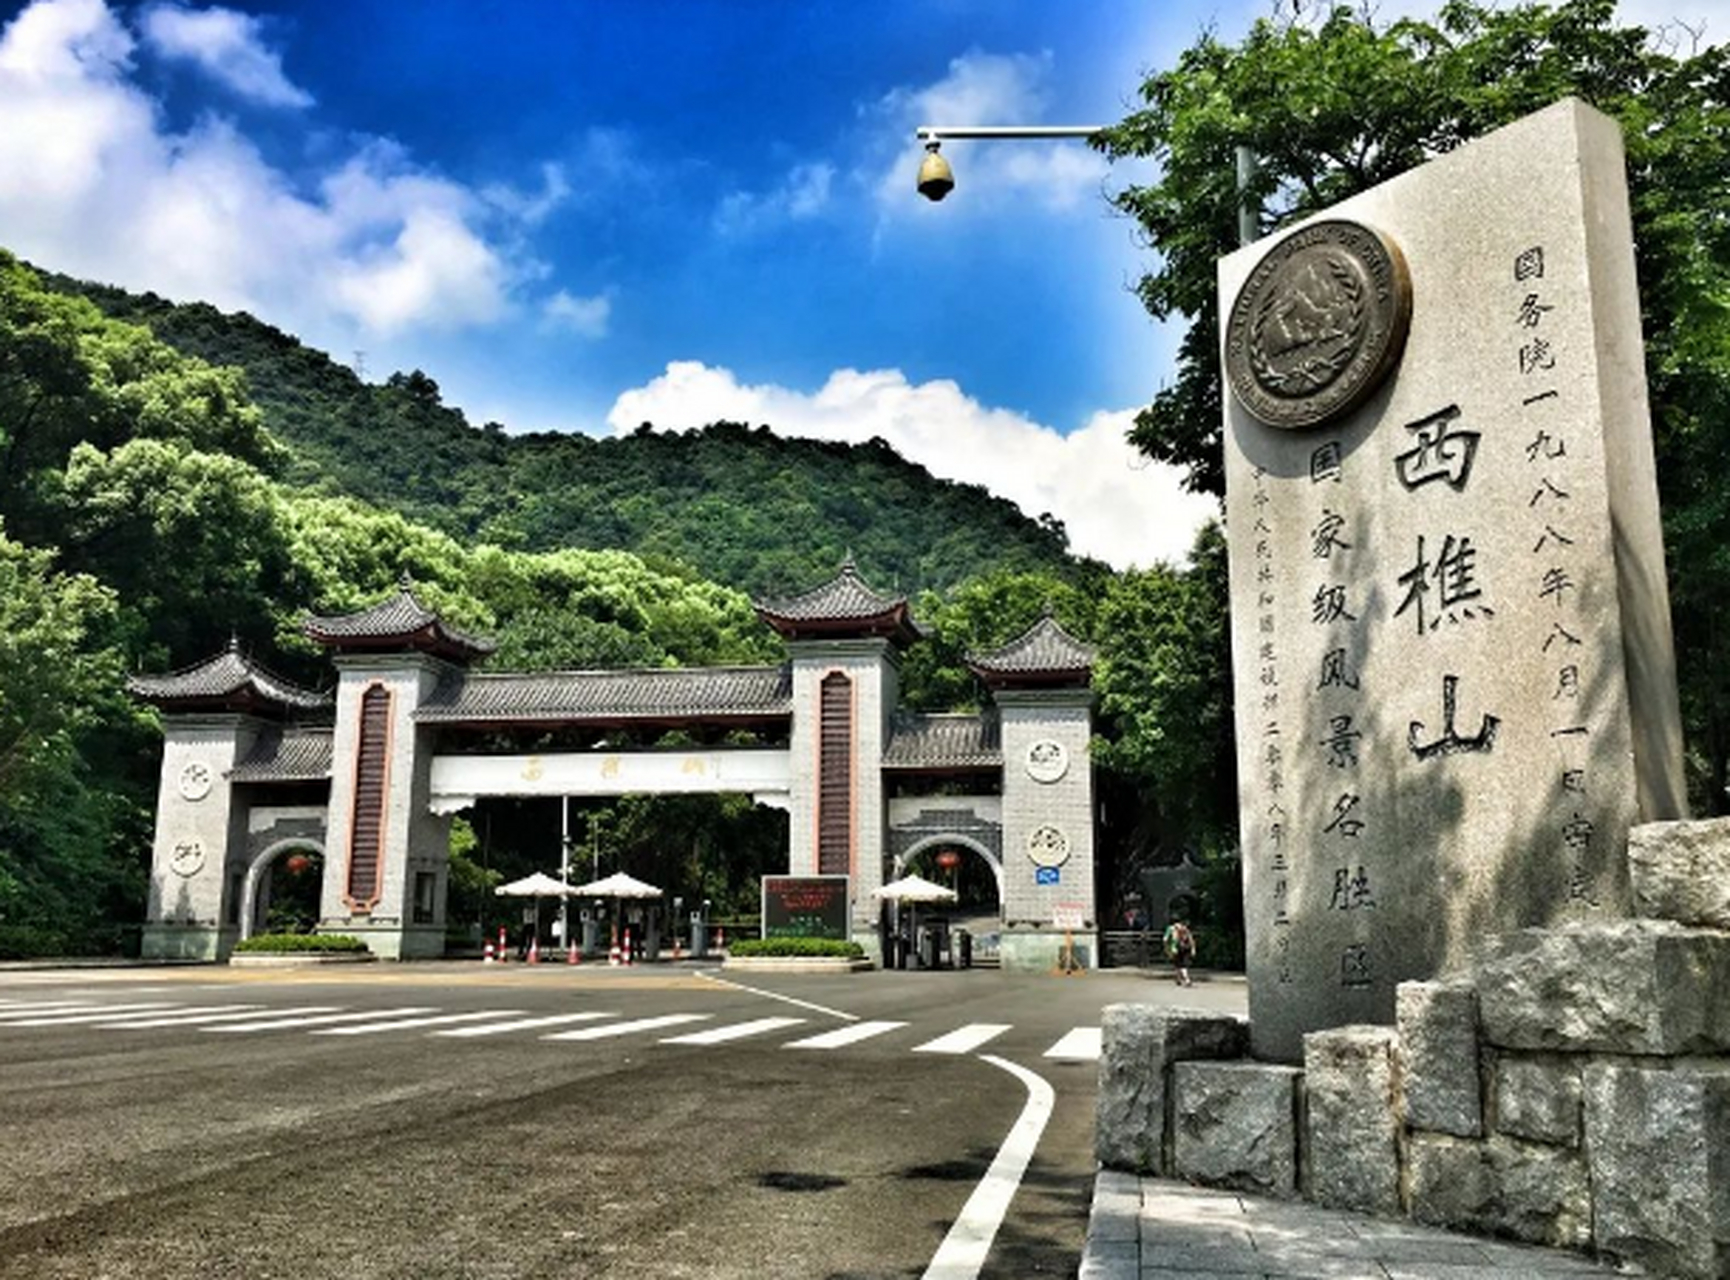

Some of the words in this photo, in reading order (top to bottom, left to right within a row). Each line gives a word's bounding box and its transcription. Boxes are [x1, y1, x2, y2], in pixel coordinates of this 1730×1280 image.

[1310, 441, 1376, 988] 国家级风景名胜区
[1394, 404, 1501, 762] 西樵山
